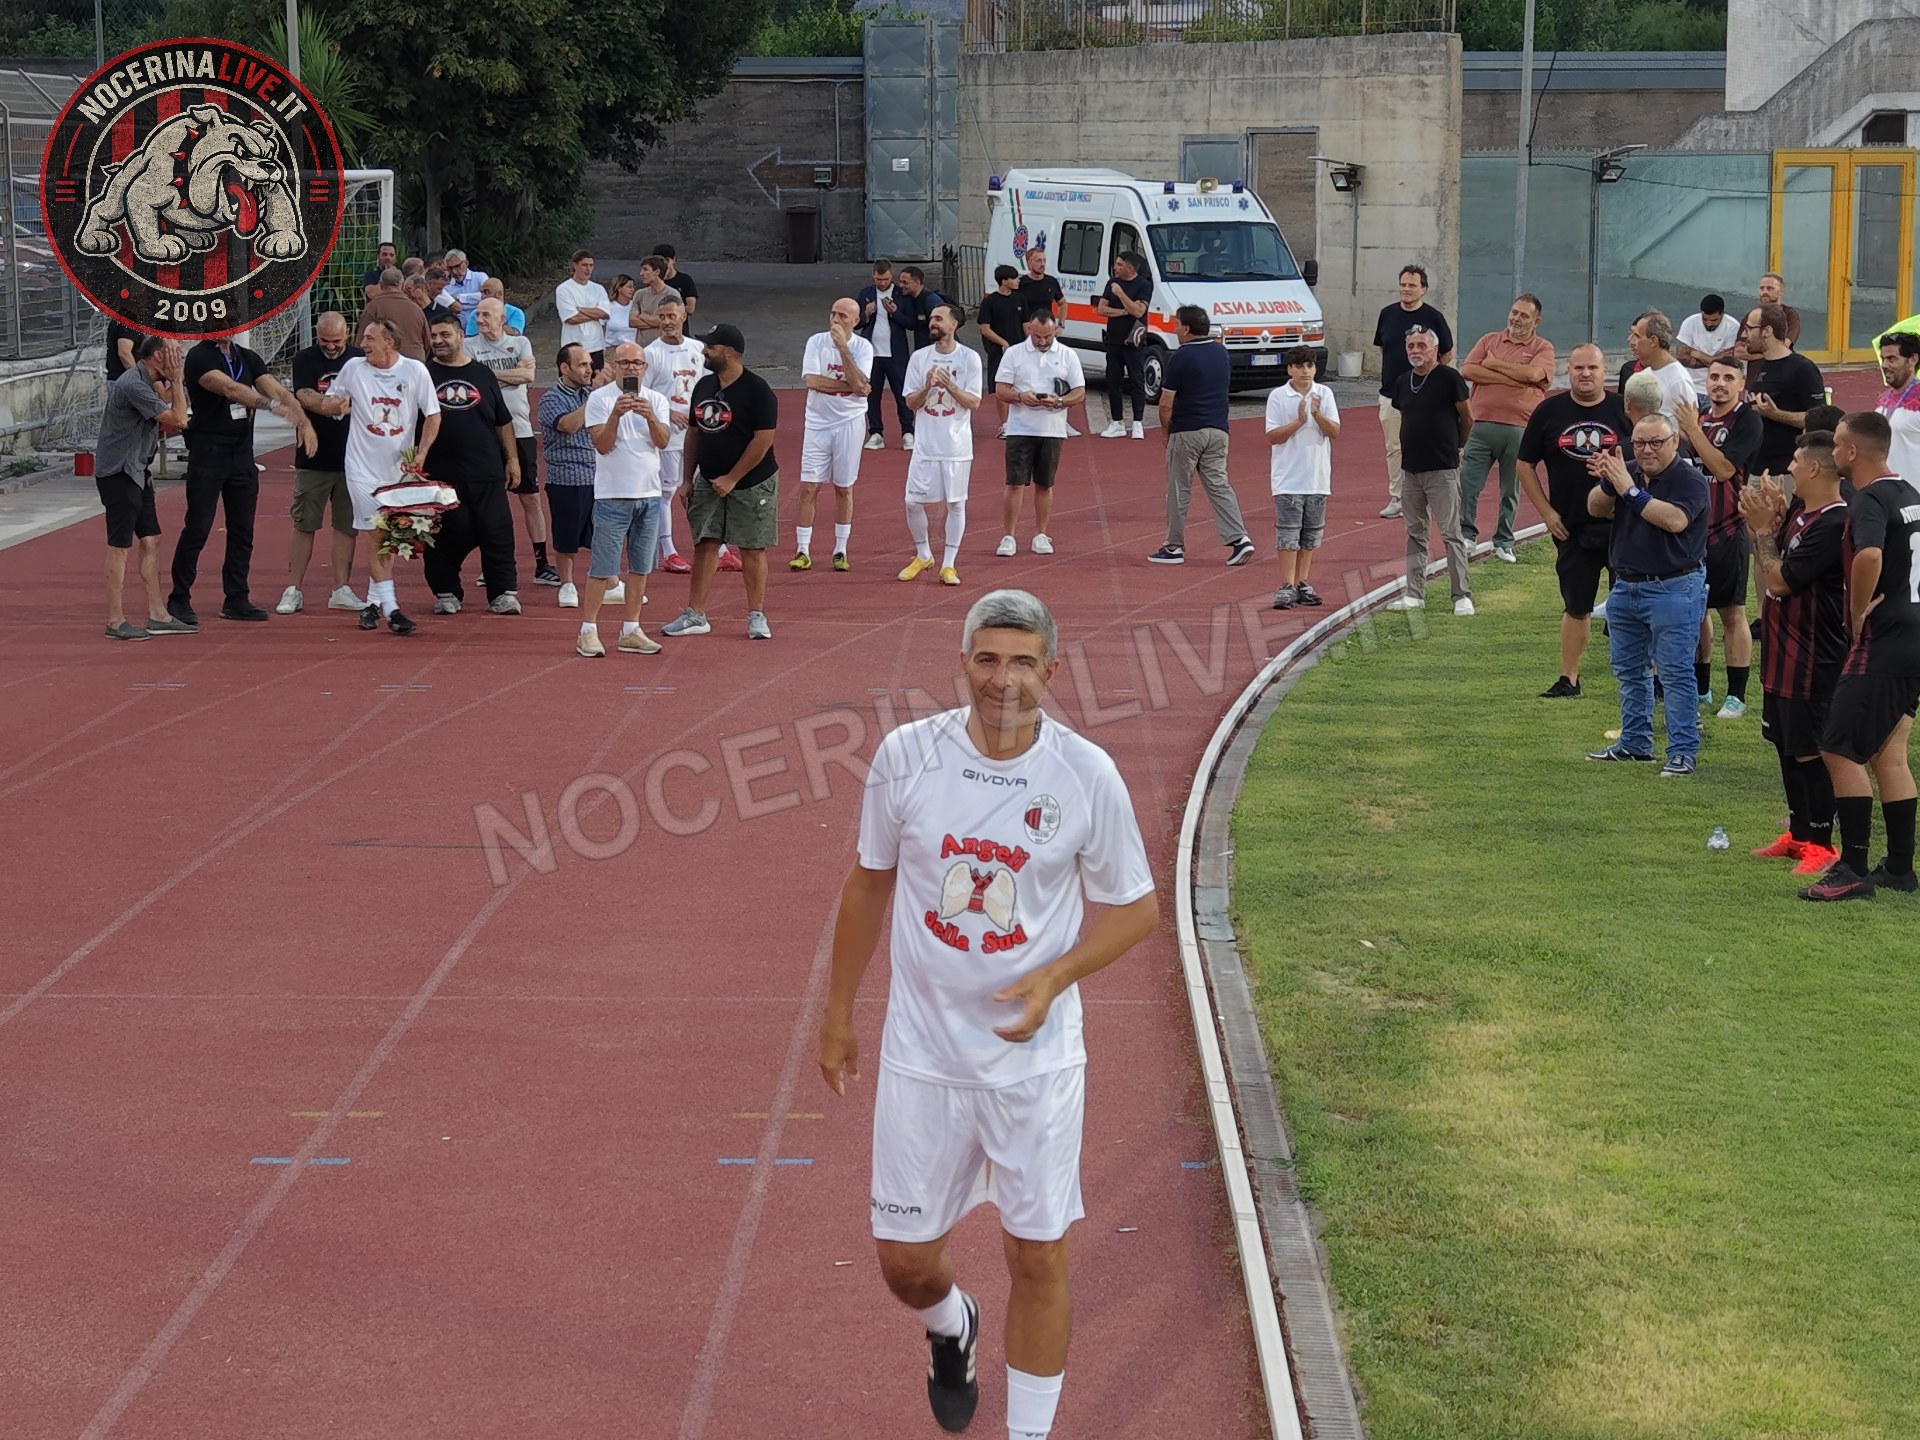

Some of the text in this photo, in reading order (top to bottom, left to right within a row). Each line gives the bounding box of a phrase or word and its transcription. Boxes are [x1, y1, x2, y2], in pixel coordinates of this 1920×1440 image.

[1187, 196, 1230, 208] SAN PRISCO
[962, 768, 1028, 788] GIVOVA
[940, 833, 1031, 873] Angeli
[925, 910, 1029, 954] della Sud
